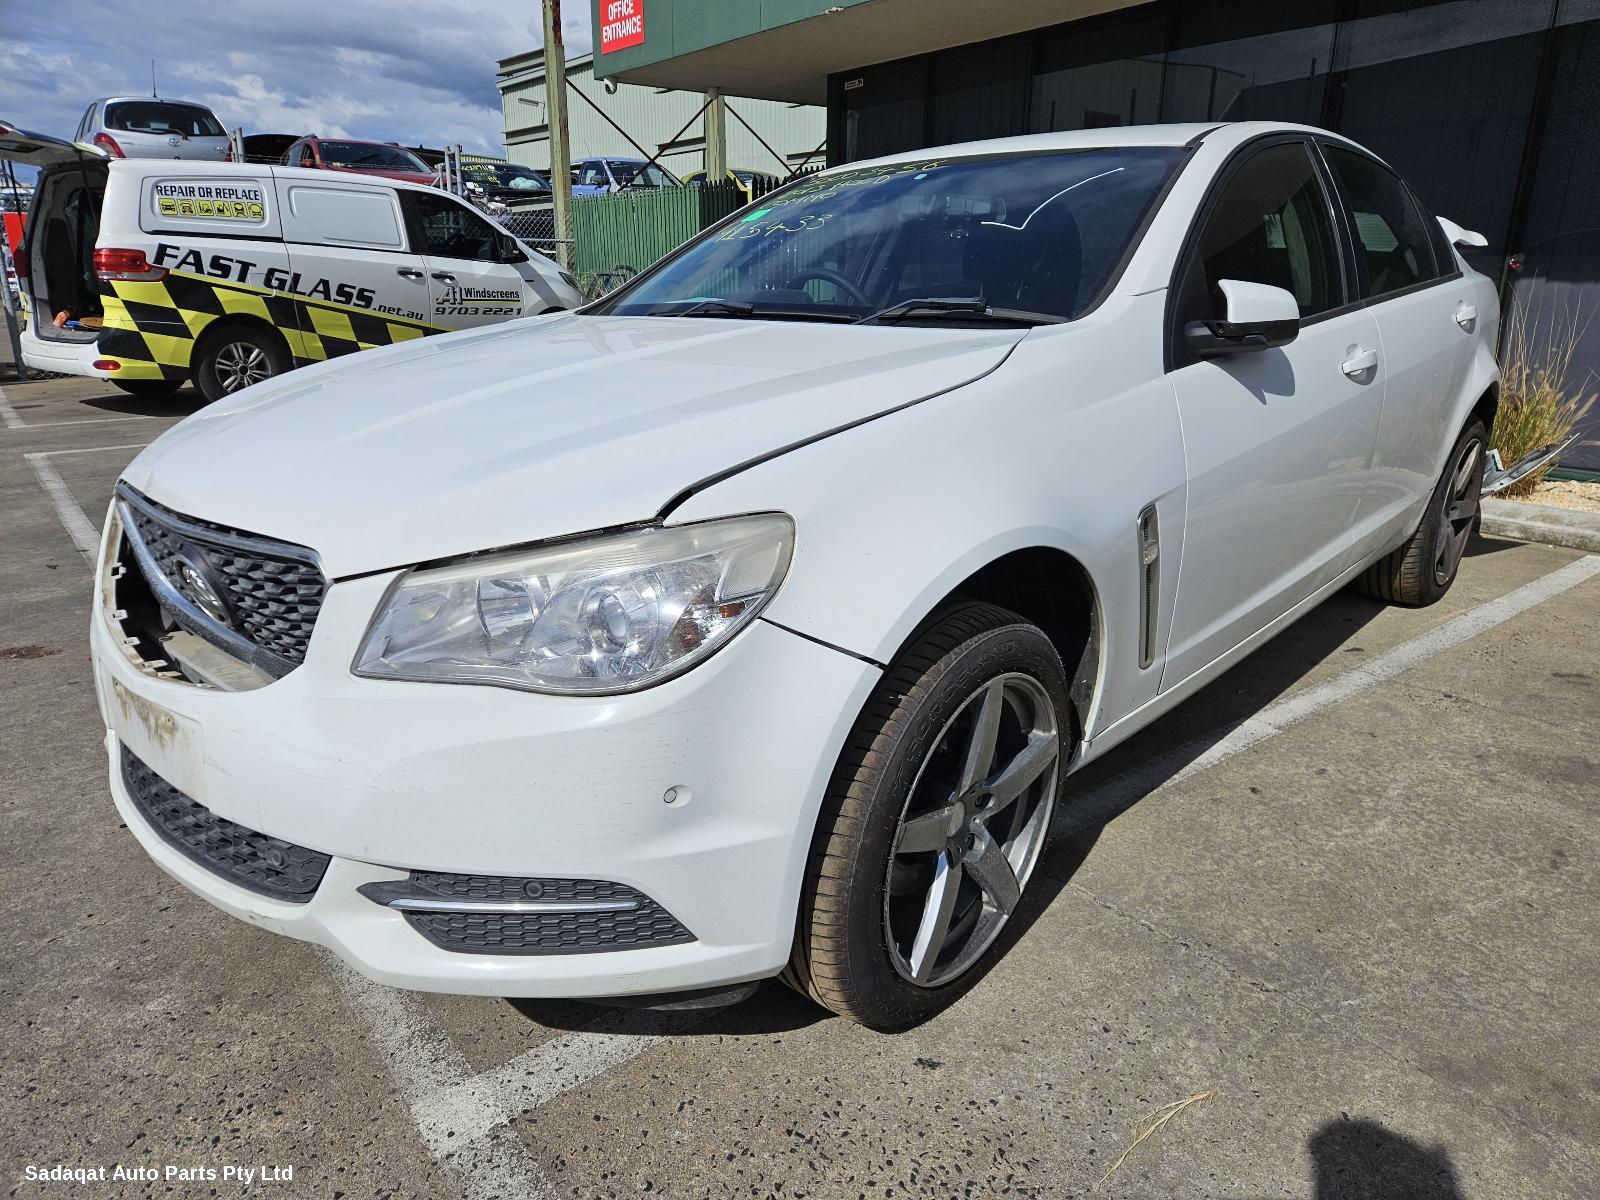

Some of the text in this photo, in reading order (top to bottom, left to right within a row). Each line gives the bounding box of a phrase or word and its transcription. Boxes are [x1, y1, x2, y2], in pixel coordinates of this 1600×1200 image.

[608, 0, 634, 21] OFFICE
[602, 15, 642, 43] ENTRANCE
[156, 185, 260, 200] REPAIR OR REPLACE
[153, 243, 257, 283] FAST
[263, 267, 376, 308] GLASS
[464, 287, 520, 299] Windscreens
[434, 306, 522, 315] 9703 2221
